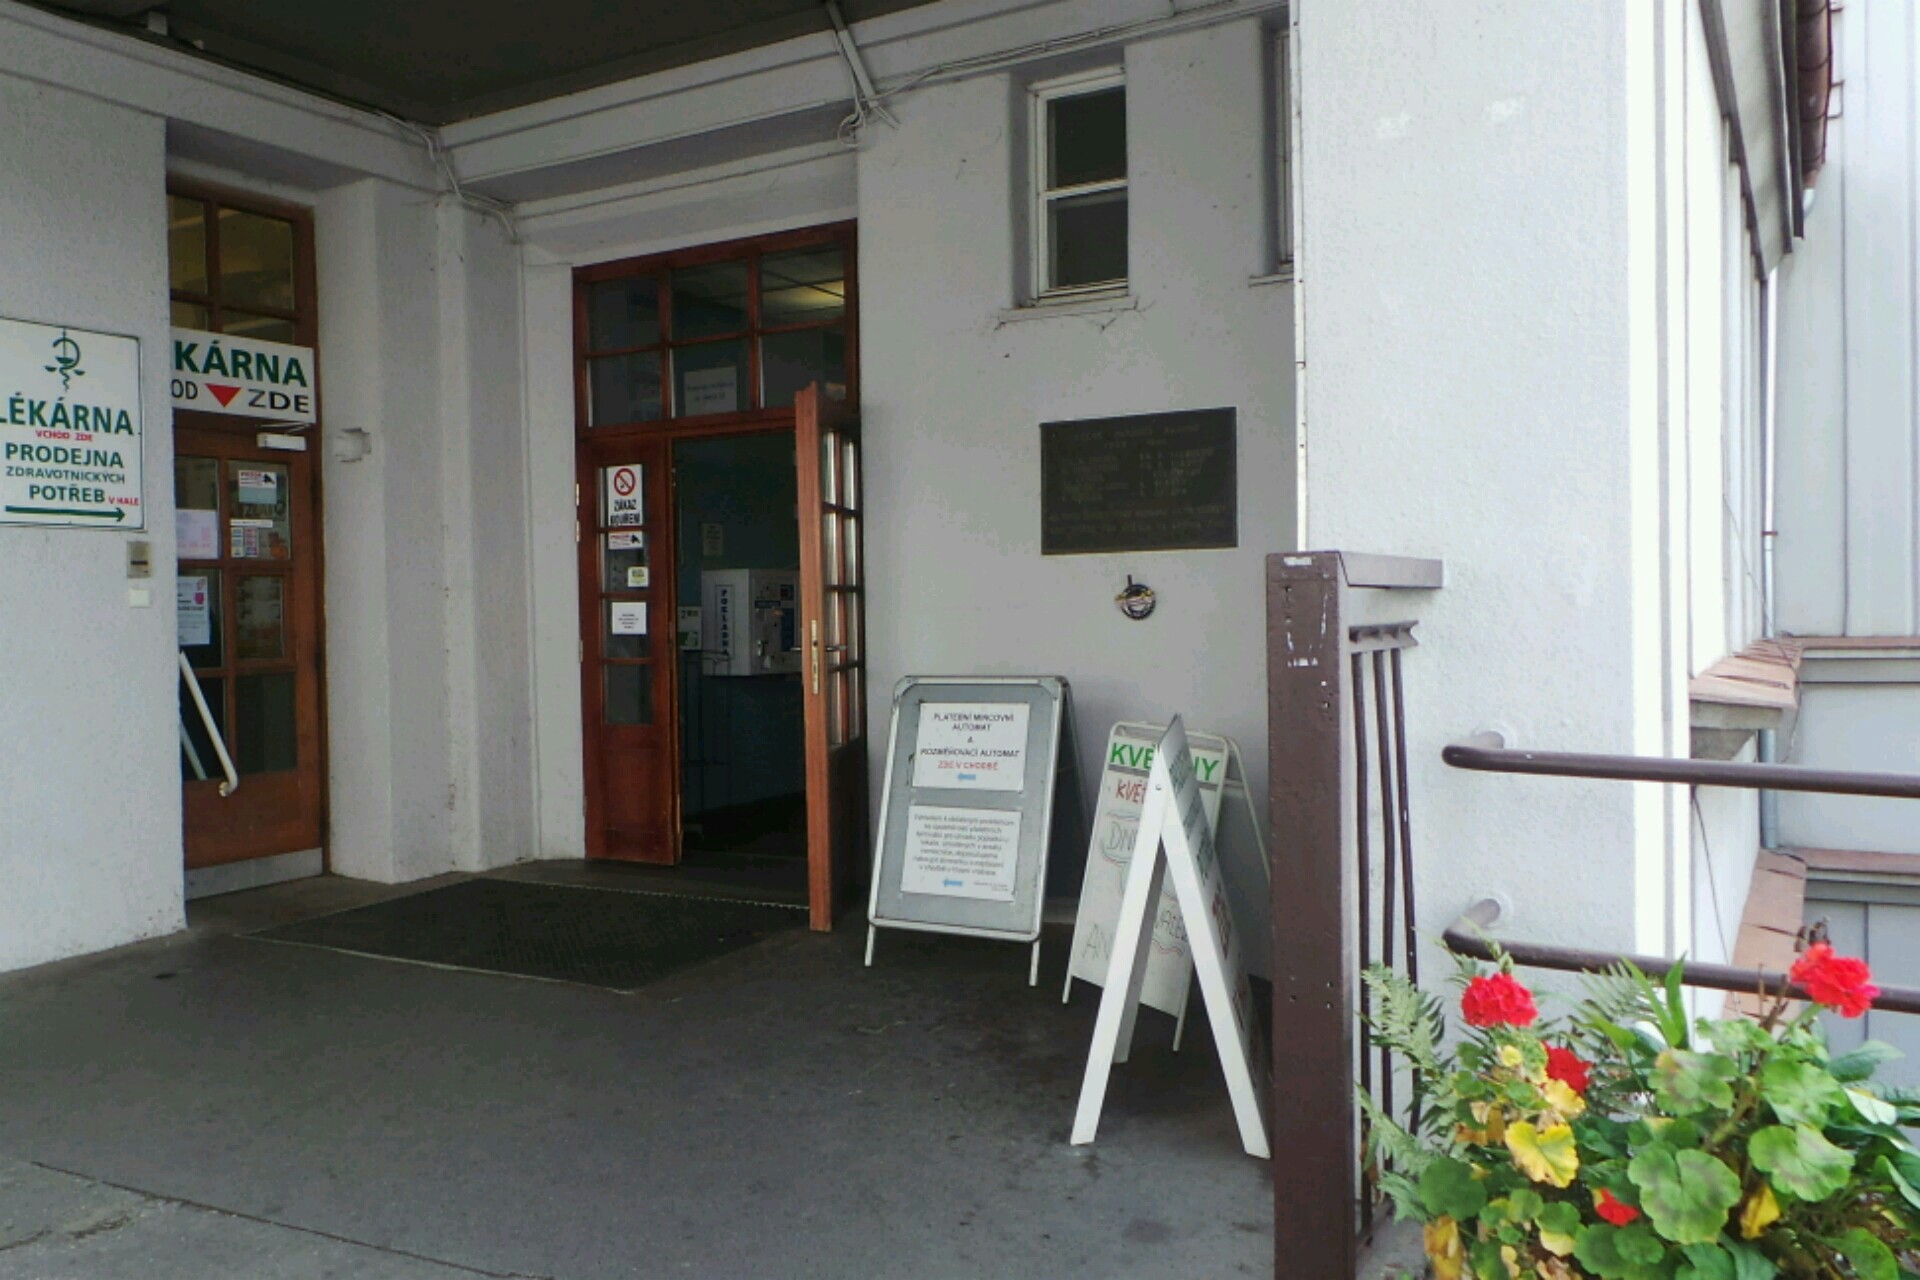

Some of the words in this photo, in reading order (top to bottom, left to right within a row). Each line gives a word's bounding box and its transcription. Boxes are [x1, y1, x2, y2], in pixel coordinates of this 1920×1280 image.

[247, 388, 309, 413] ZDE
[36, 430, 70, 440] VCHOD
[75, 432, 93, 441] ZDE
[5, 442, 124, 468] PRODEJNA
[5, 466, 125, 483] ZDRAVOTNICKÝCH
[29, 484, 105, 502] POTŘEB
[952, 723, 991, 731] AUTOMAT
